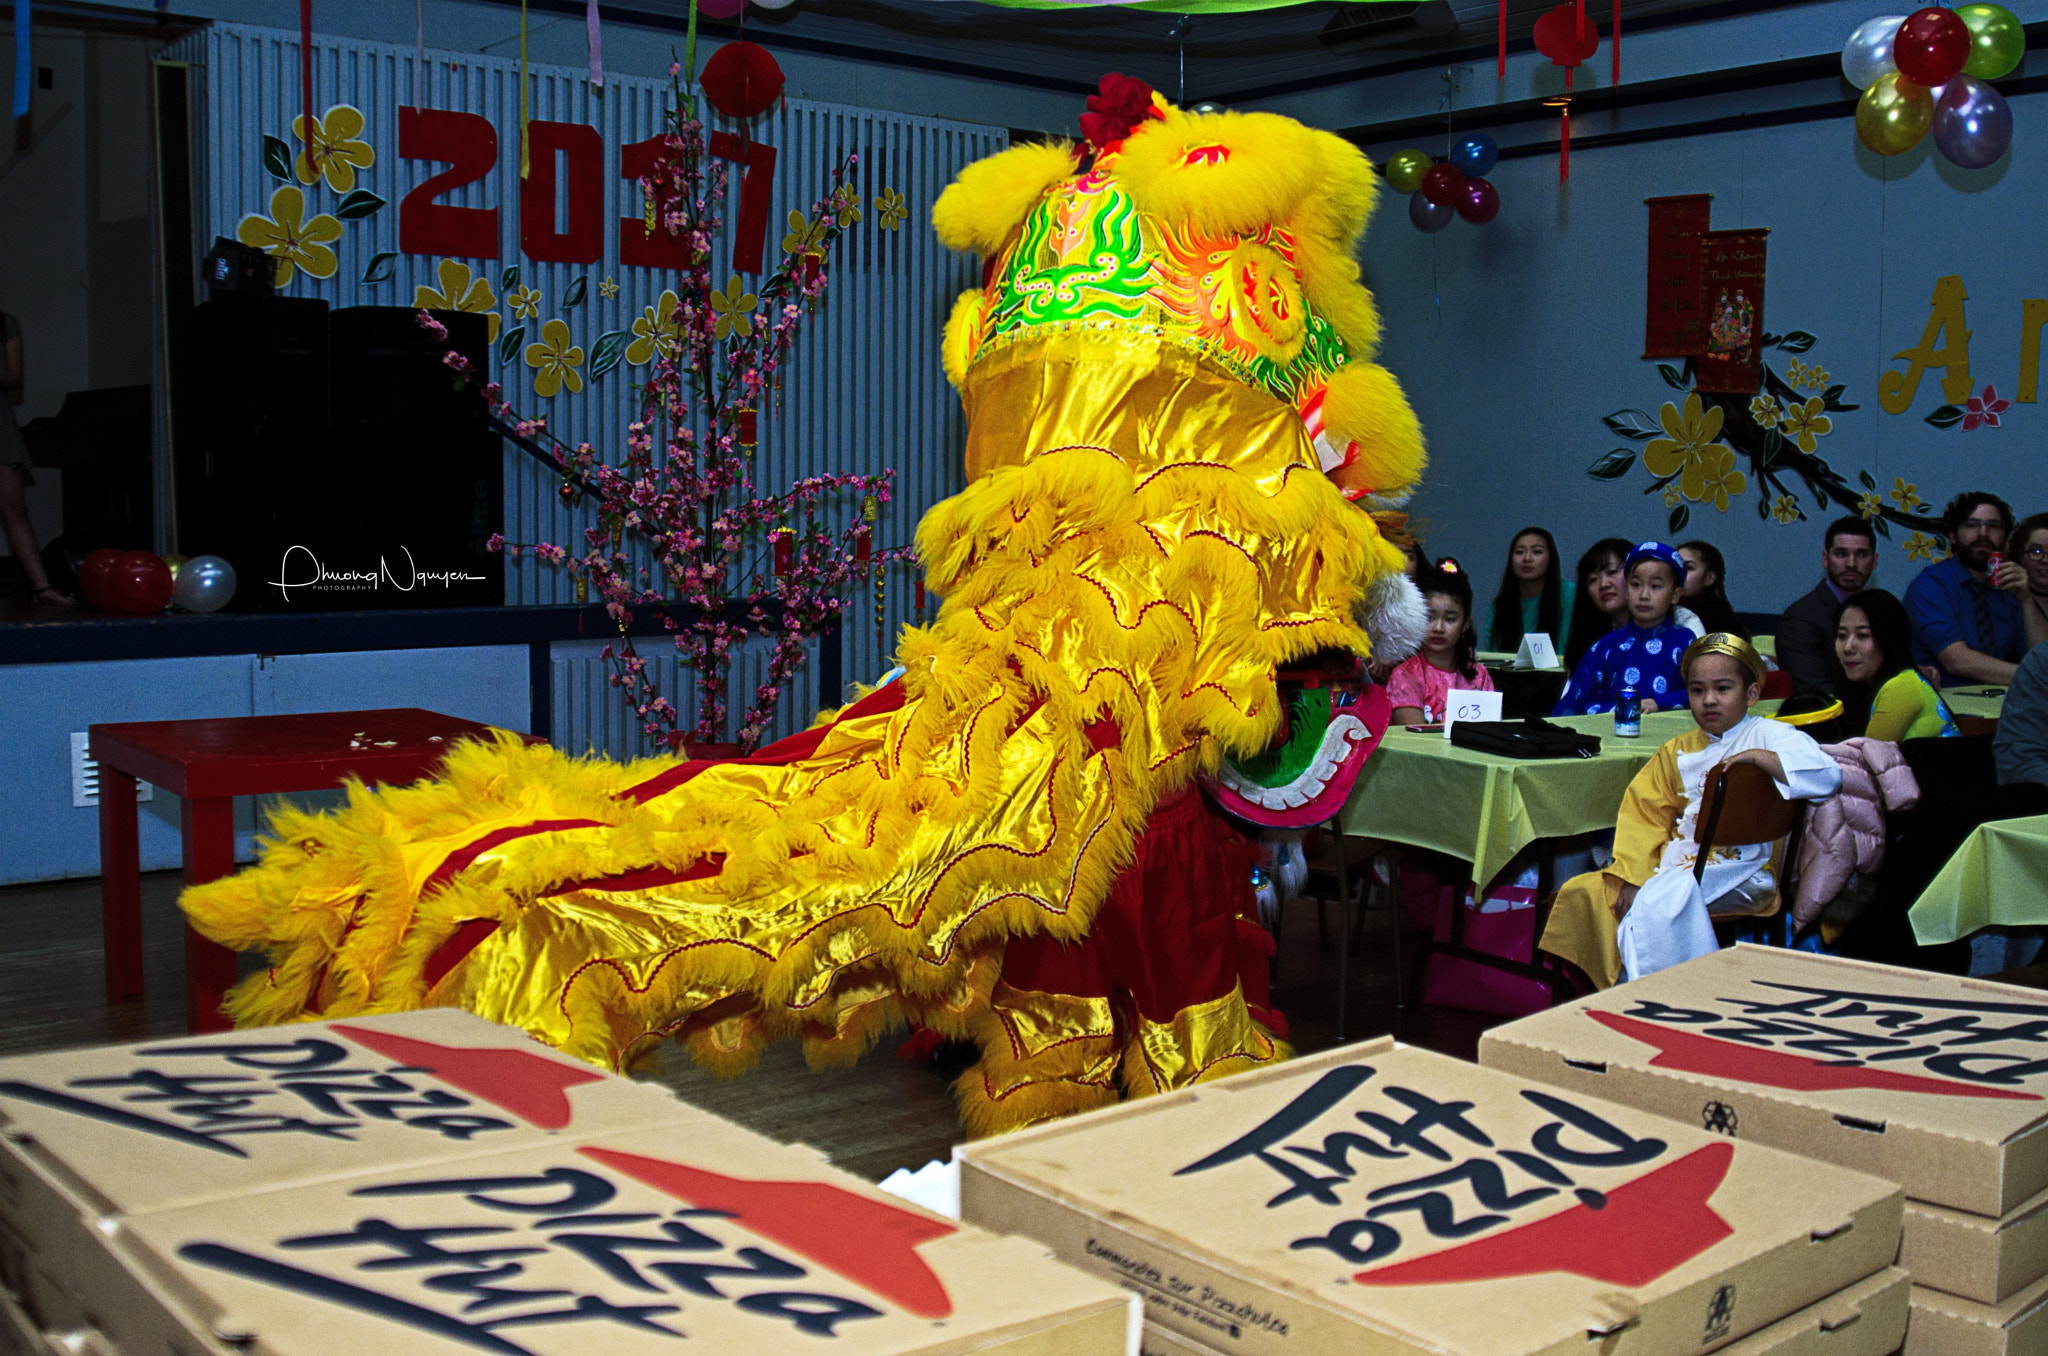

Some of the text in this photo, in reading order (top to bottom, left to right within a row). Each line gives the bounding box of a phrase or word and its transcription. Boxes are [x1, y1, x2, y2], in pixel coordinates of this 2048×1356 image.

[398, 105, 777, 275] 2017
[1457, 704, 1482, 720] 03
[136, 1038, 516, 1140] Pizza
[1622, 999, 2048, 1085] Pizza
[0, 1069, 362, 1159] Hut
[1173, 1064, 1493, 1208] Hut
[1289, 1086, 1668, 1262] Pizza
[178, 1218, 690, 1356] Hut
[350, 1167, 886, 1338] Pizza
